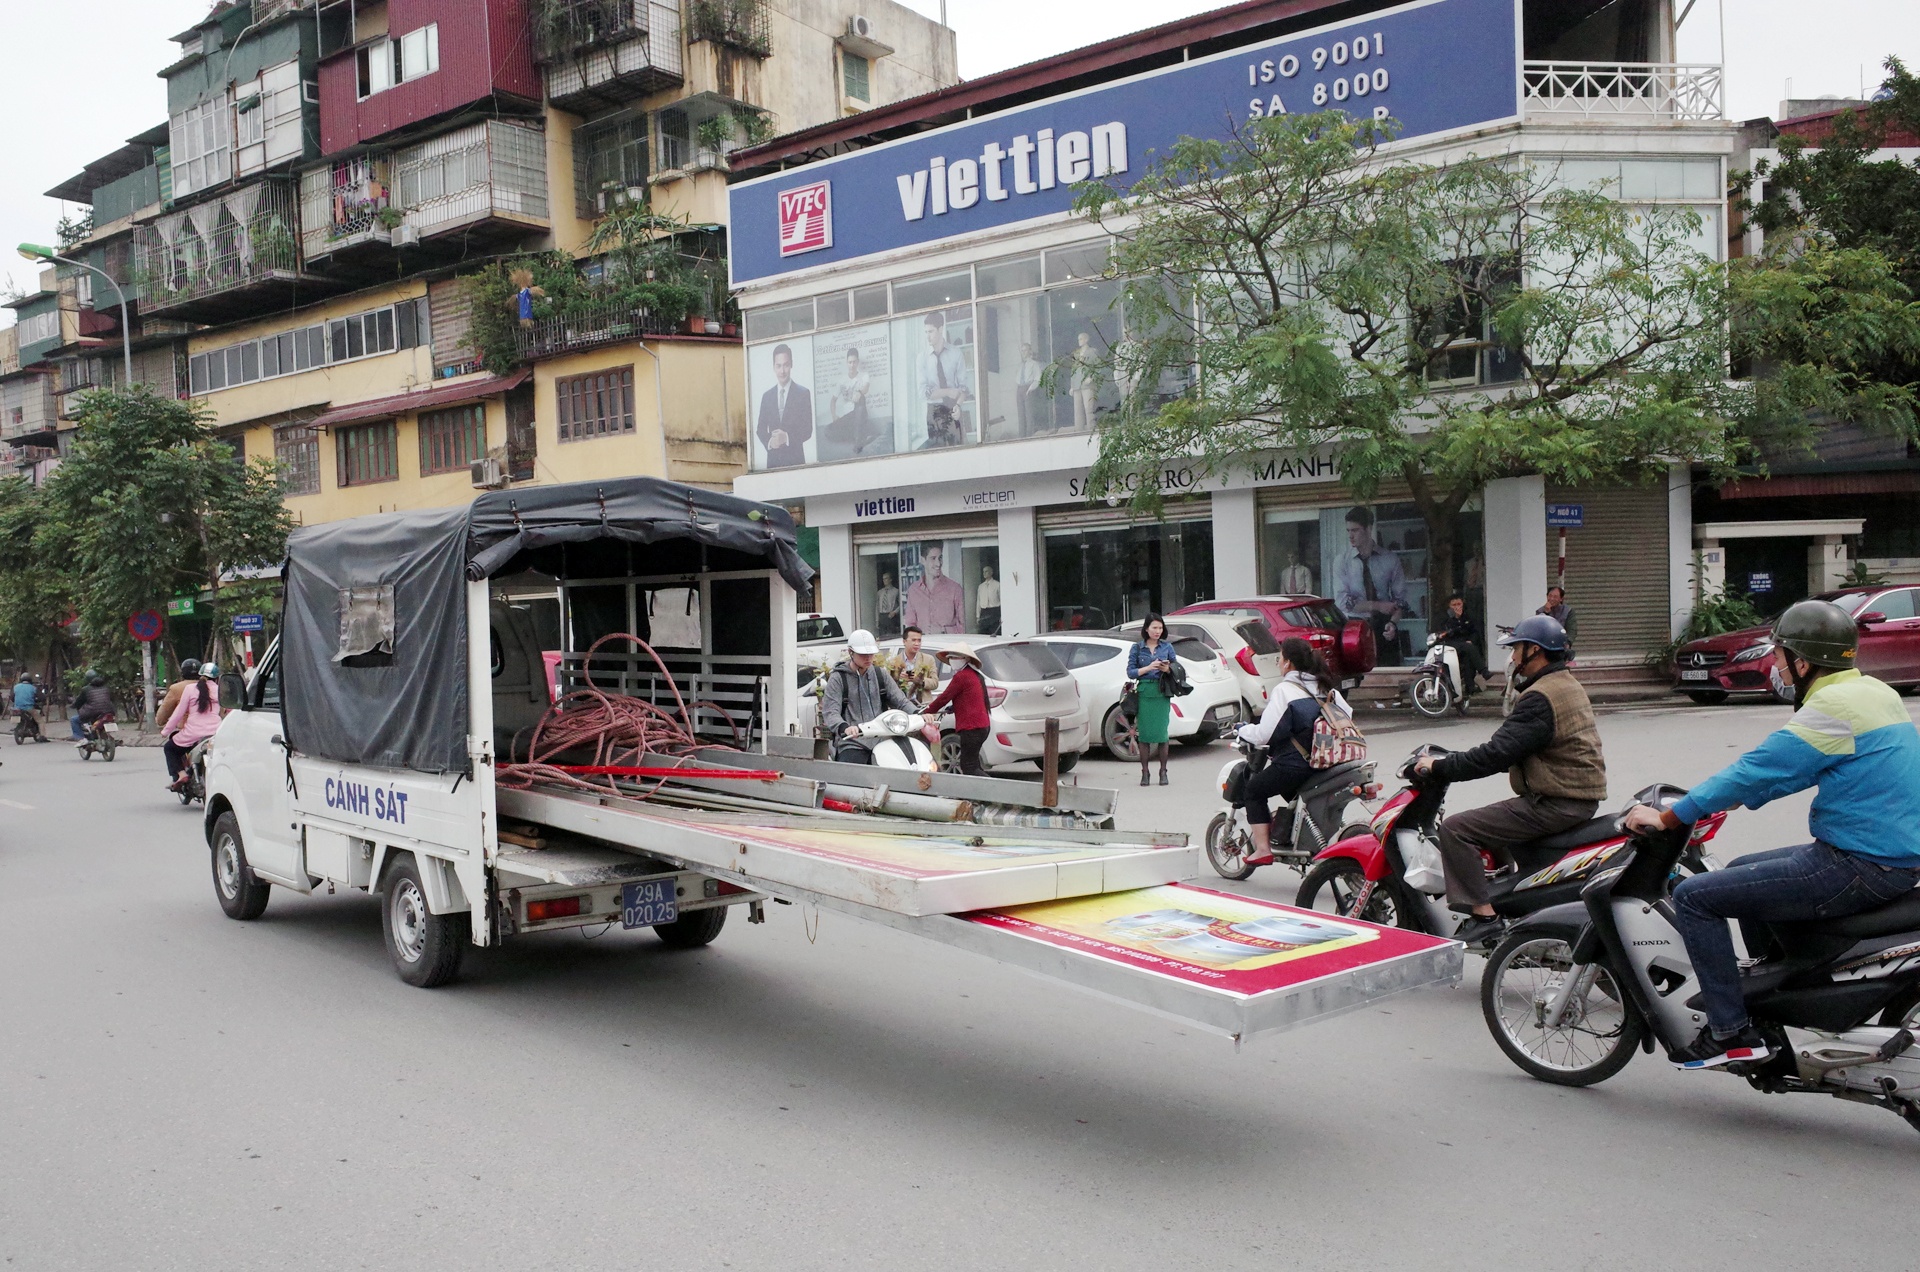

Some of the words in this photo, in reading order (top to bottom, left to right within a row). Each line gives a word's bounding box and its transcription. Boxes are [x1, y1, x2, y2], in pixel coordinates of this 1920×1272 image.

[1249, 54, 1300, 87] ISO
[1311, 32, 1384, 71] 9001
[1249, 94, 1287, 119] SA
[1312, 68, 1389, 106] 8000
[896, 121, 1128, 222] viettien
[782, 186, 825, 222] VTEC
[855, 497, 915, 517] viettien
[963, 490, 1016, 505] viettien
[325, 770, 369, 816] CẢNH
[375, 782, 408, 825] SÁT
[635, 883, 664, 905] 29A
[625, 901, 675, 926] 020.25
